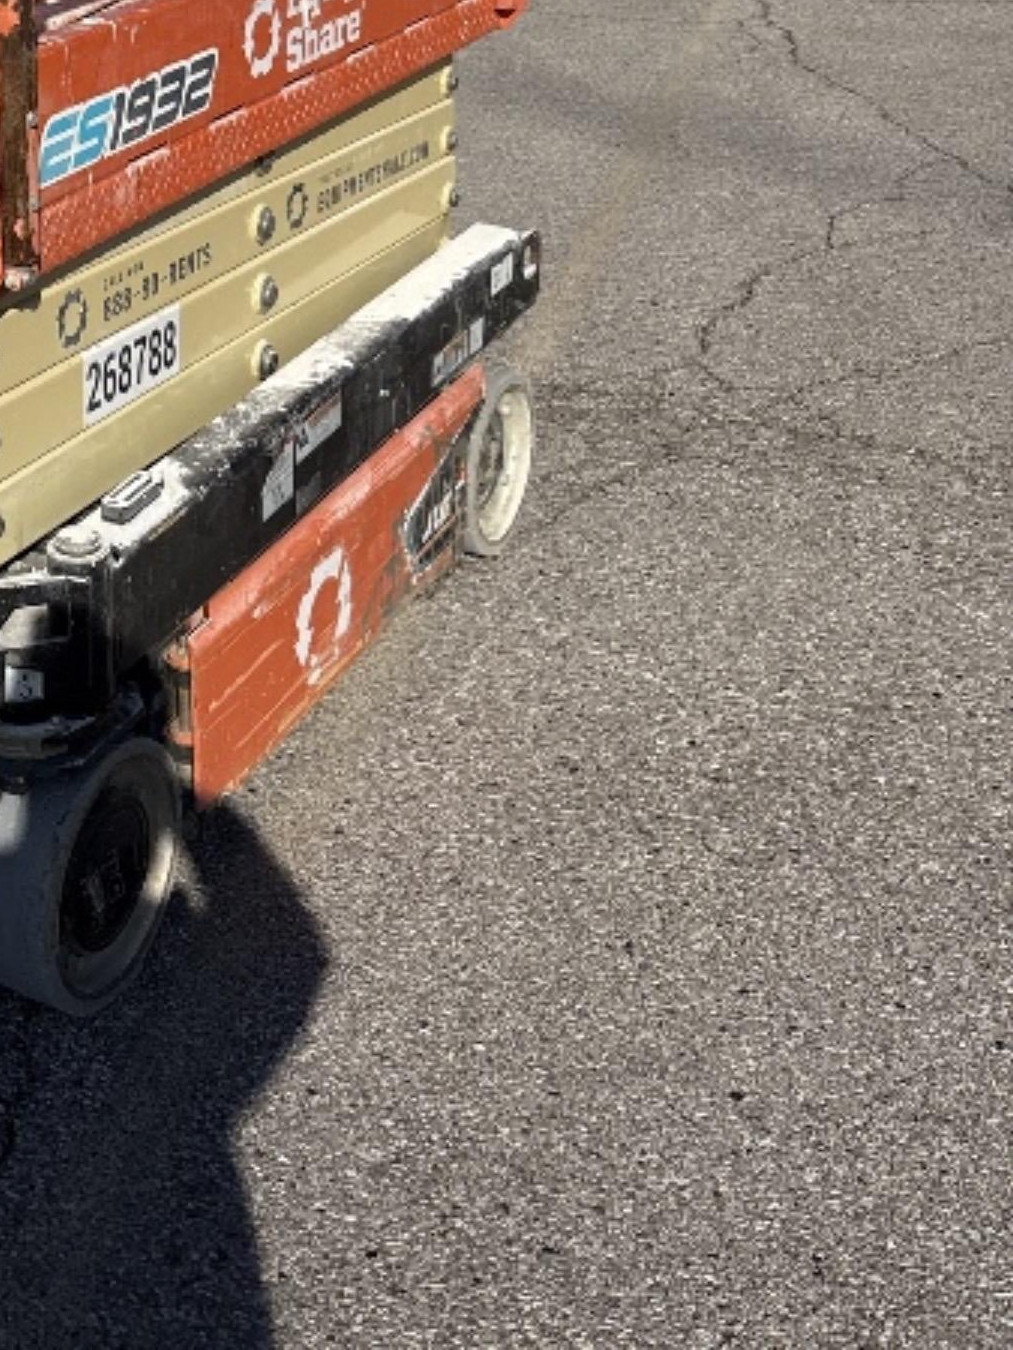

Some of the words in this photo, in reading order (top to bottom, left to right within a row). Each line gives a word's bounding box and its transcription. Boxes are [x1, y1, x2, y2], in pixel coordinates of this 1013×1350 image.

[286, 9, 361, 73] Share
[39, 48, 220, 188] ES1932
[86, 320, 177, 414] 268788
